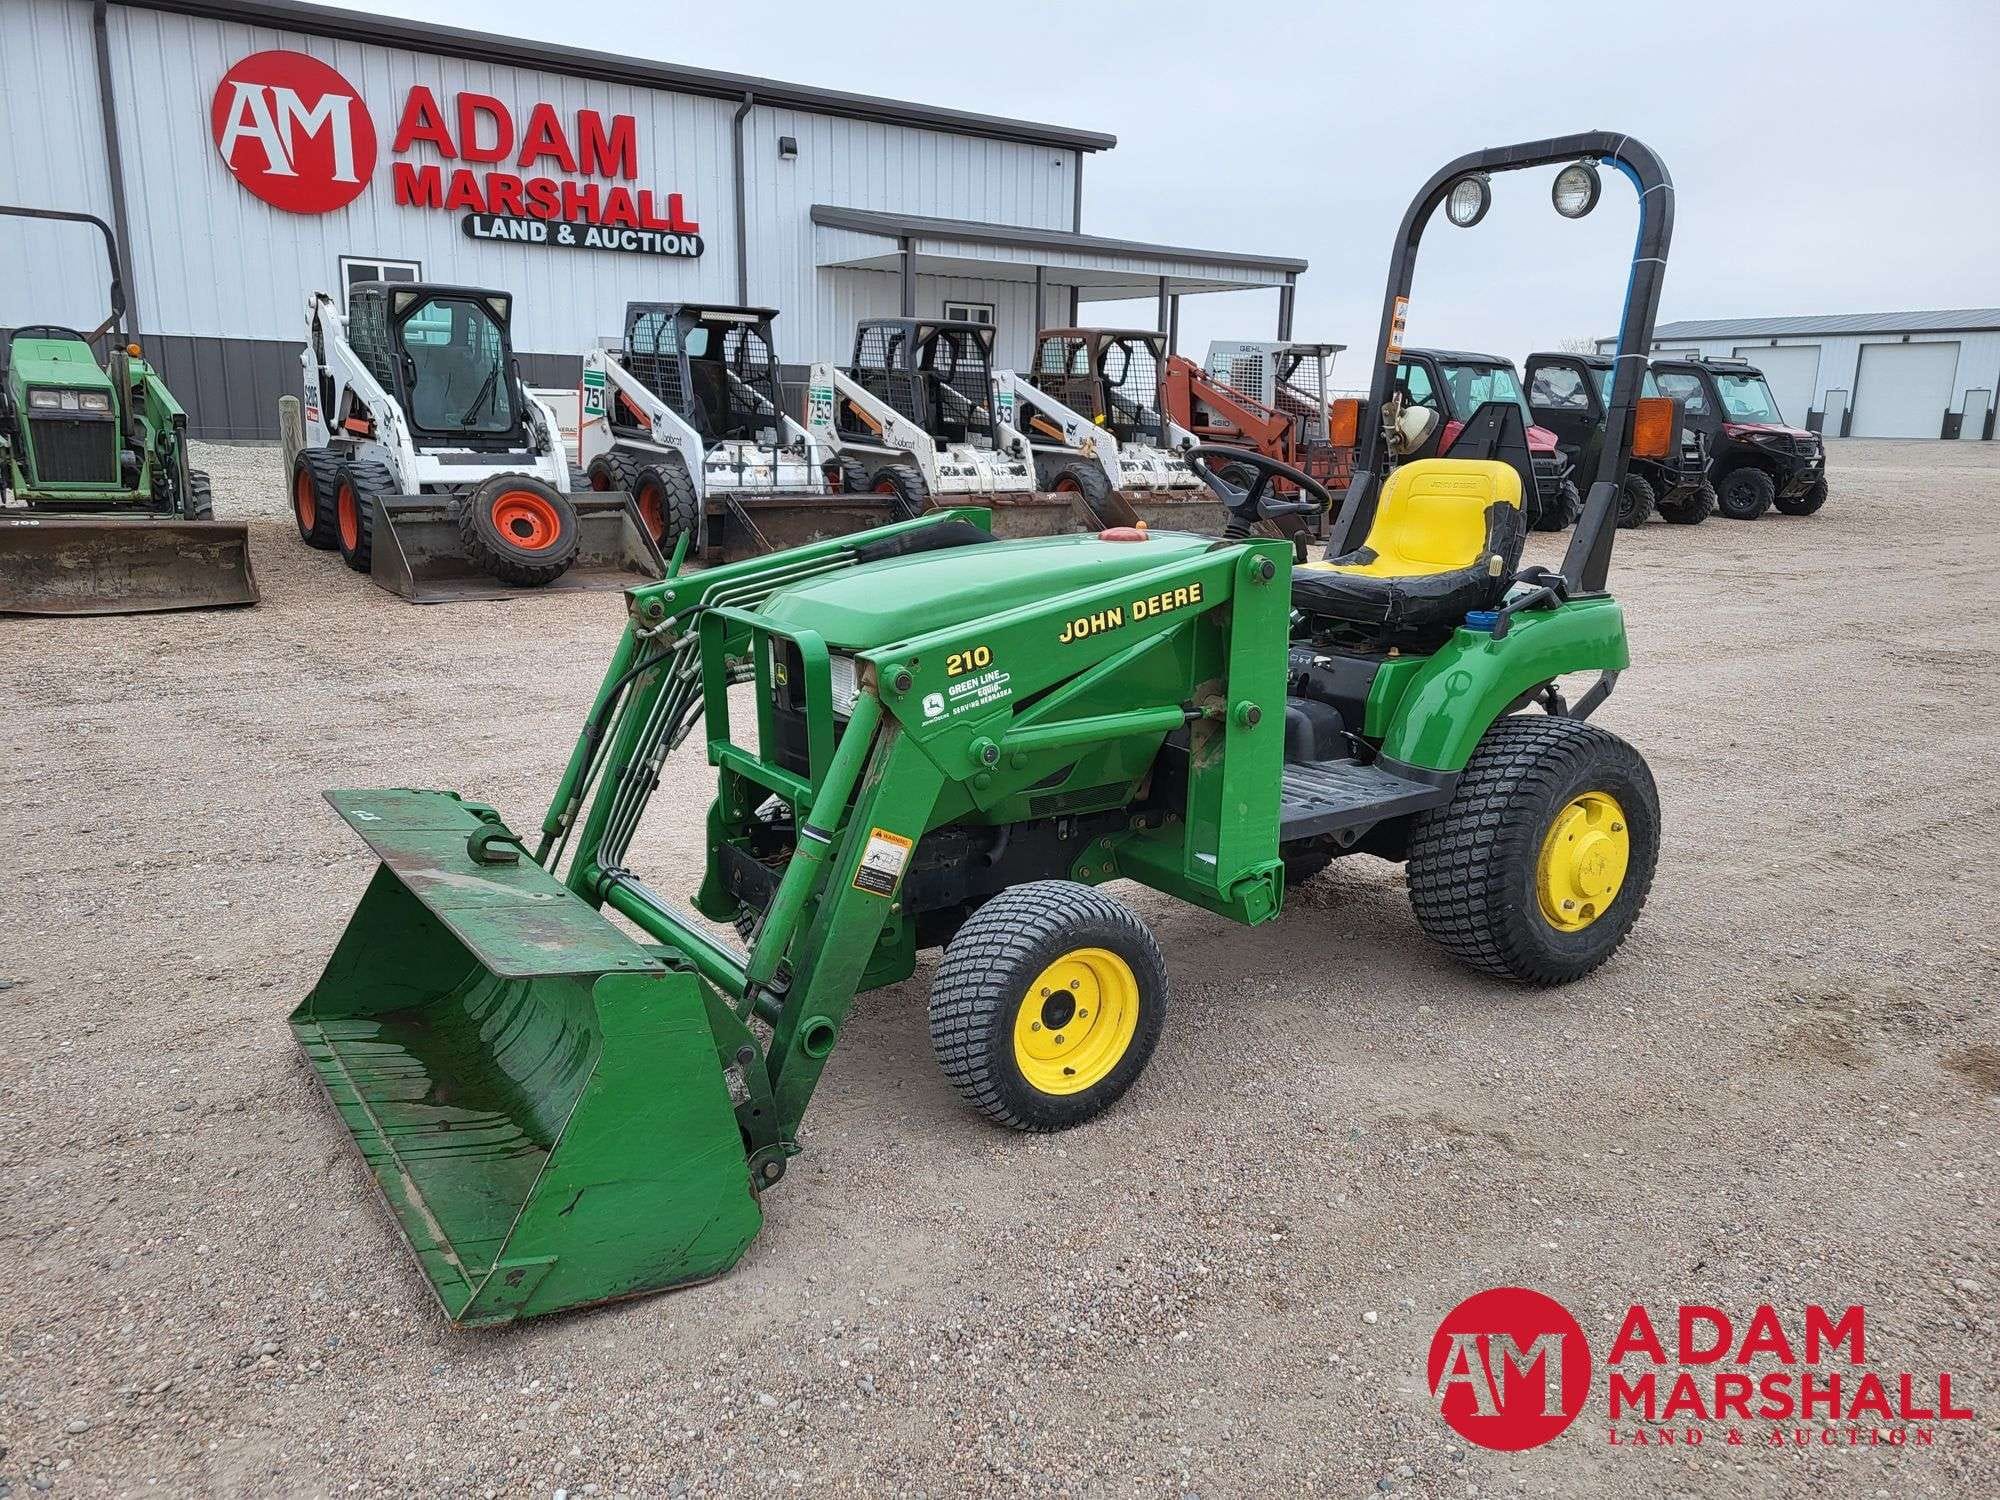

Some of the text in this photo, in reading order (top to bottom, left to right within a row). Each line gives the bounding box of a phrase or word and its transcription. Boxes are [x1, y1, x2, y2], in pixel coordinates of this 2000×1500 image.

[219, 80, 360, 183] AM
[392, 85, 637, 180] ADAM
[393, 162, 699, 233] MARSHALL
[473, 216, 698, 257] LAND & AUCTION
[1239, 345, 1263, 353] GEHL
[584, 386, 605, 409] 751
[1059, 582, 1203, 644] JOHN DEERE
[946, 645, 993, 677] 210
[948, 669, 1001, 696] GREEN LINE
[952, 688, 1013, 715] SERVING NEBRASKA
